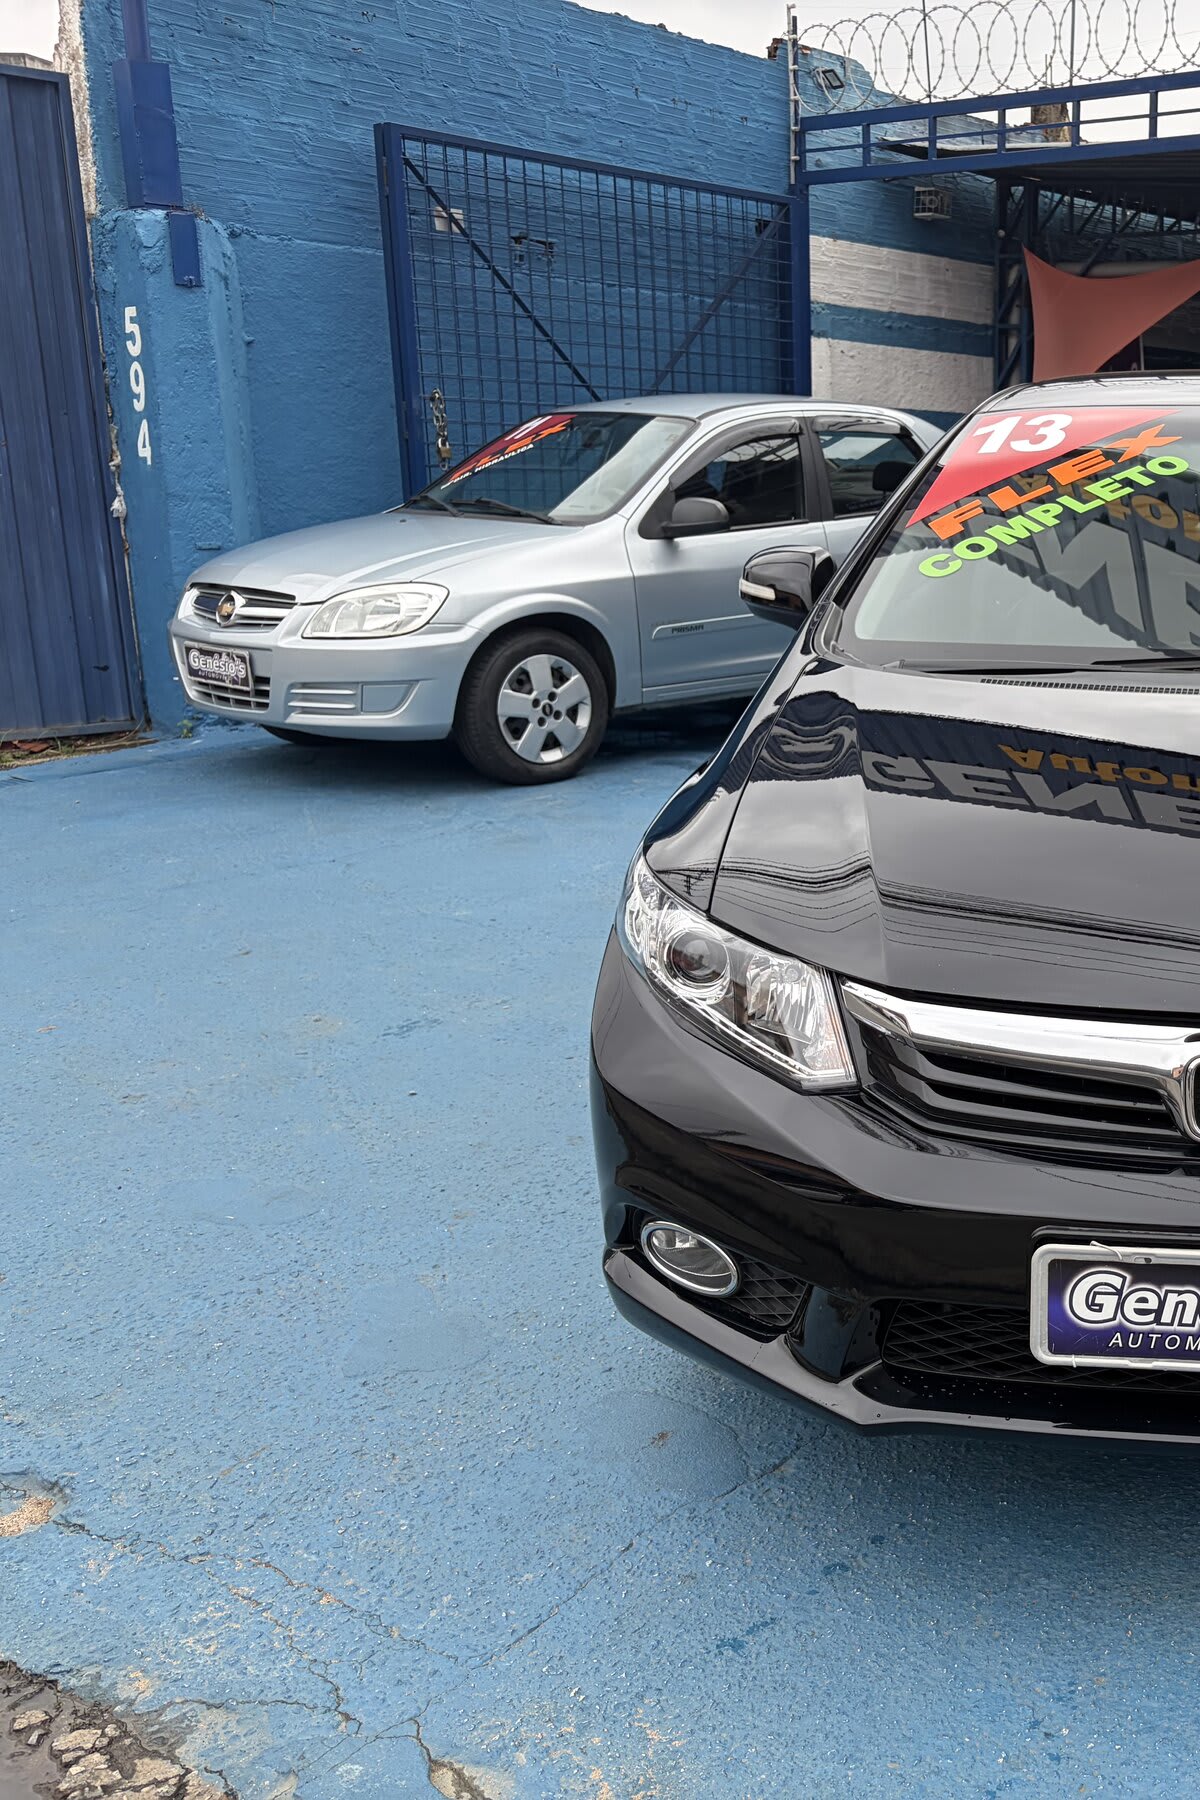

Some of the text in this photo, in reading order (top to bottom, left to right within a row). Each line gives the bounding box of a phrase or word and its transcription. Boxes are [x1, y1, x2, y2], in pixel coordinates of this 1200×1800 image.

[124, 306, 152, 466] 594
[972, 413, 1073, 454] 13
[918, 455, 1189, 578] COMPLETO
[928, 423, 1182, 541] FLEX
[671, 624, 704, 634] PRISMA
